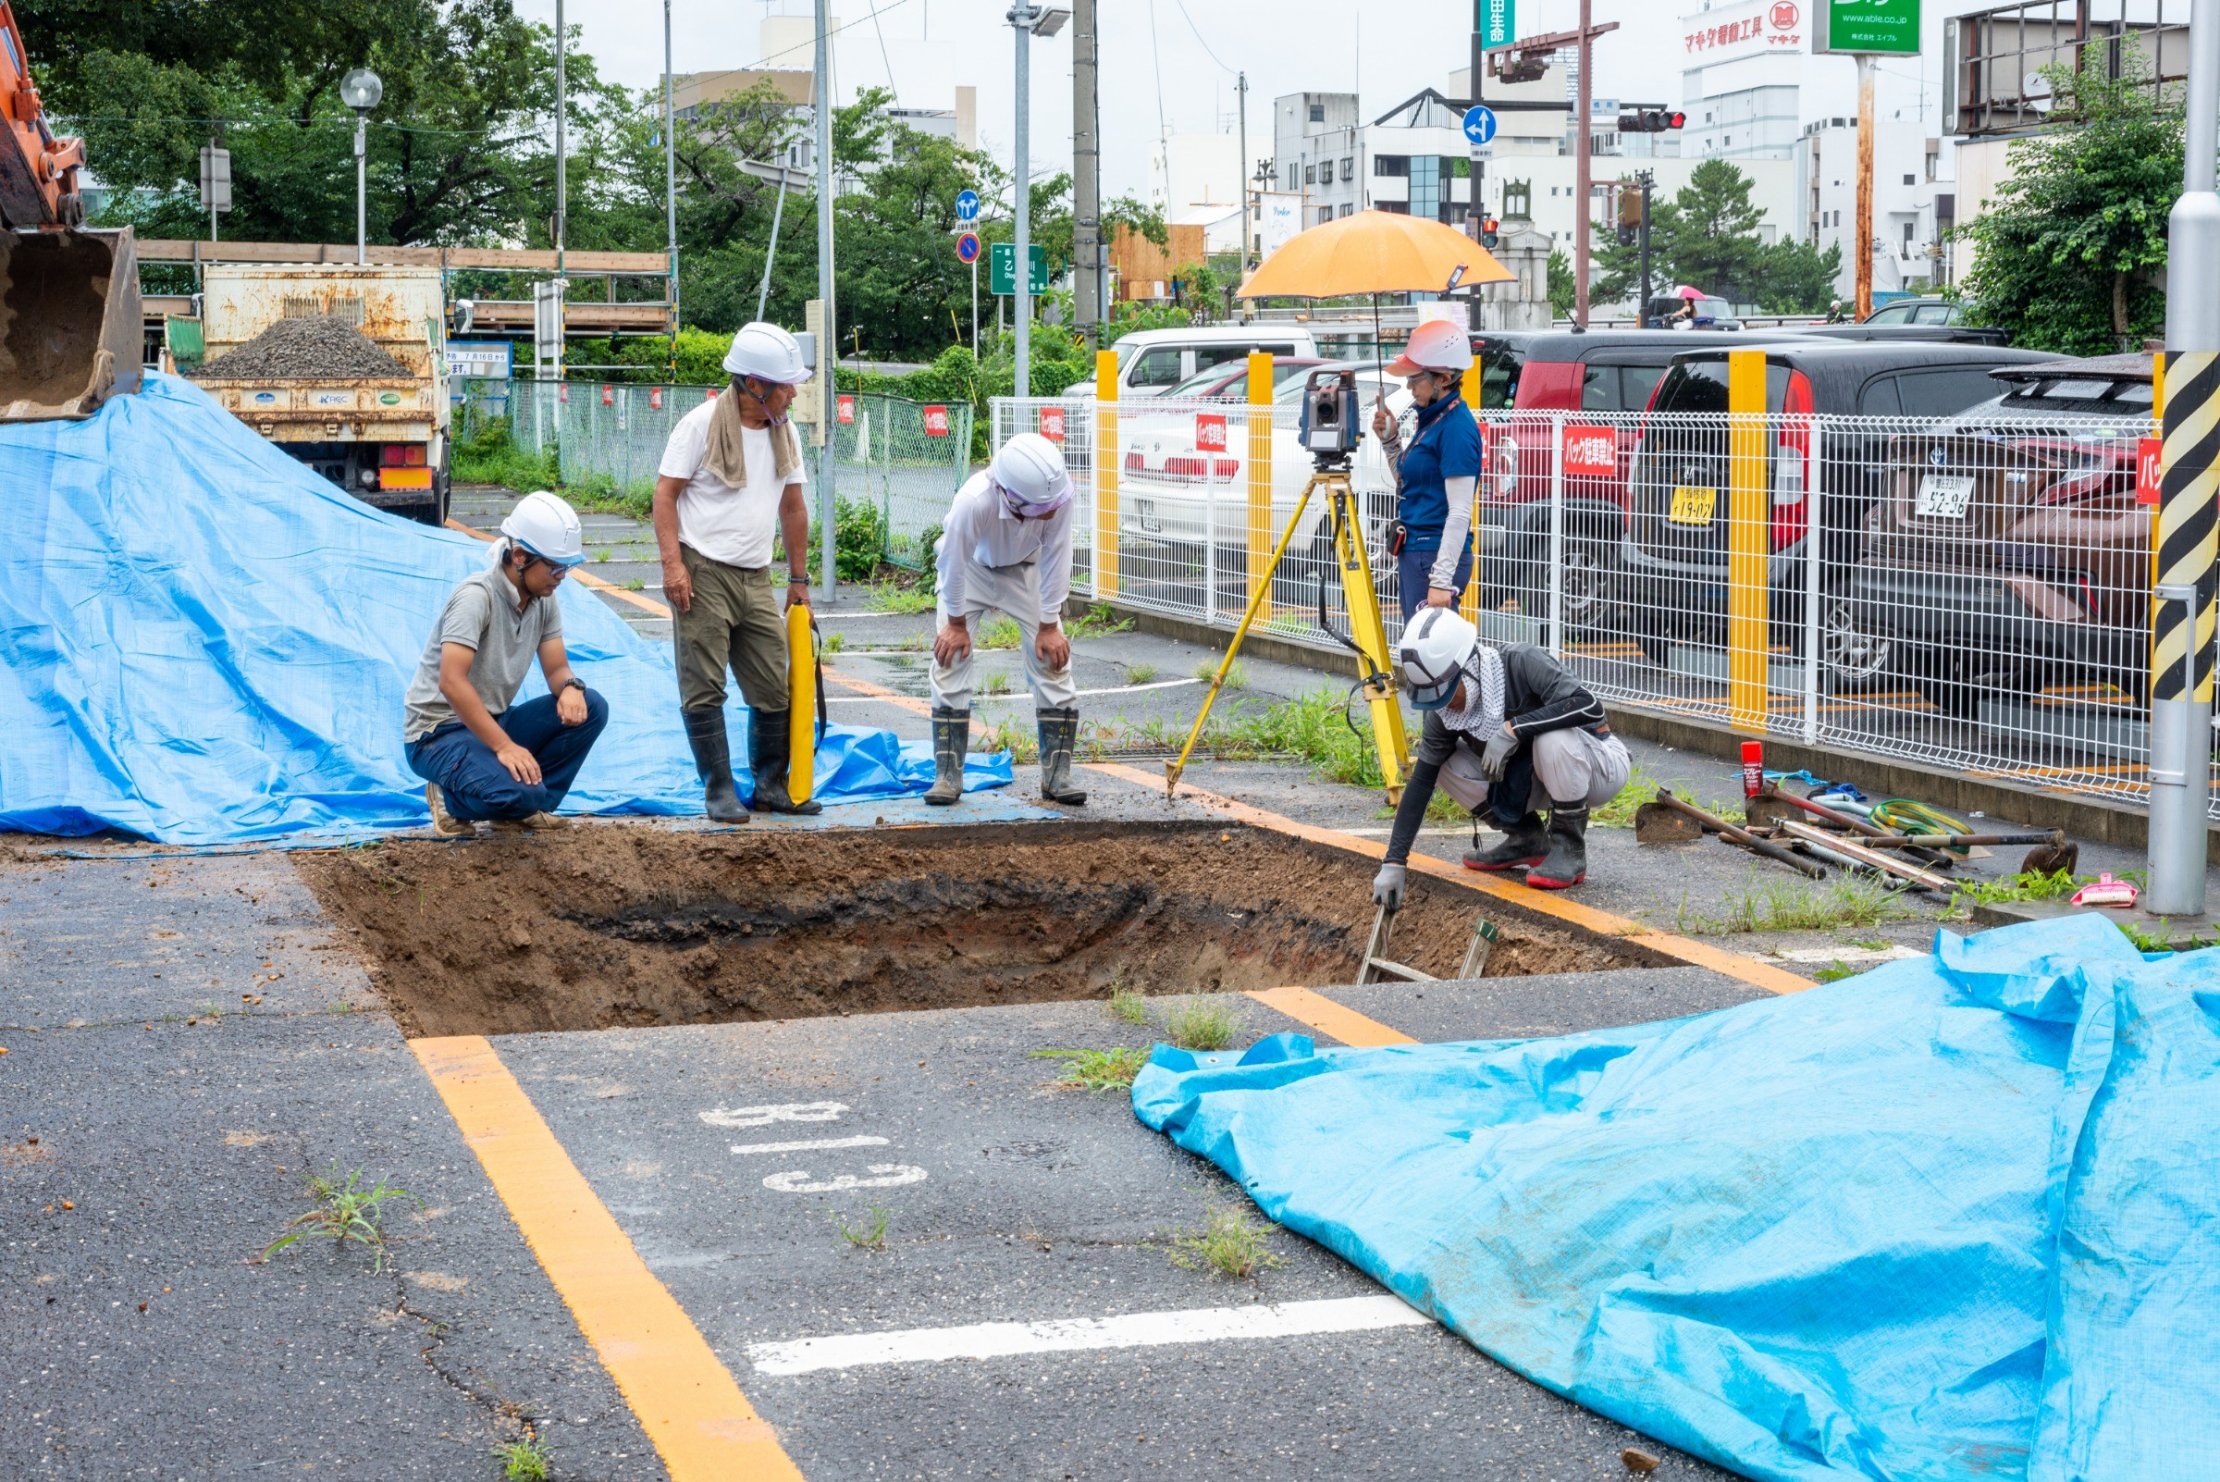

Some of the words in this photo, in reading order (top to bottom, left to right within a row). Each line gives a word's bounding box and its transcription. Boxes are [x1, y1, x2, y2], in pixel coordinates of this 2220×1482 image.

[1842, 15, 1908, 24] www.able.co.jp
[1685, 16, 1762, 54] マキタ電動工具
[1768, 35, 1800, 45] マキタ
[1565, 437, 1614, 466] バック駐車禁止
